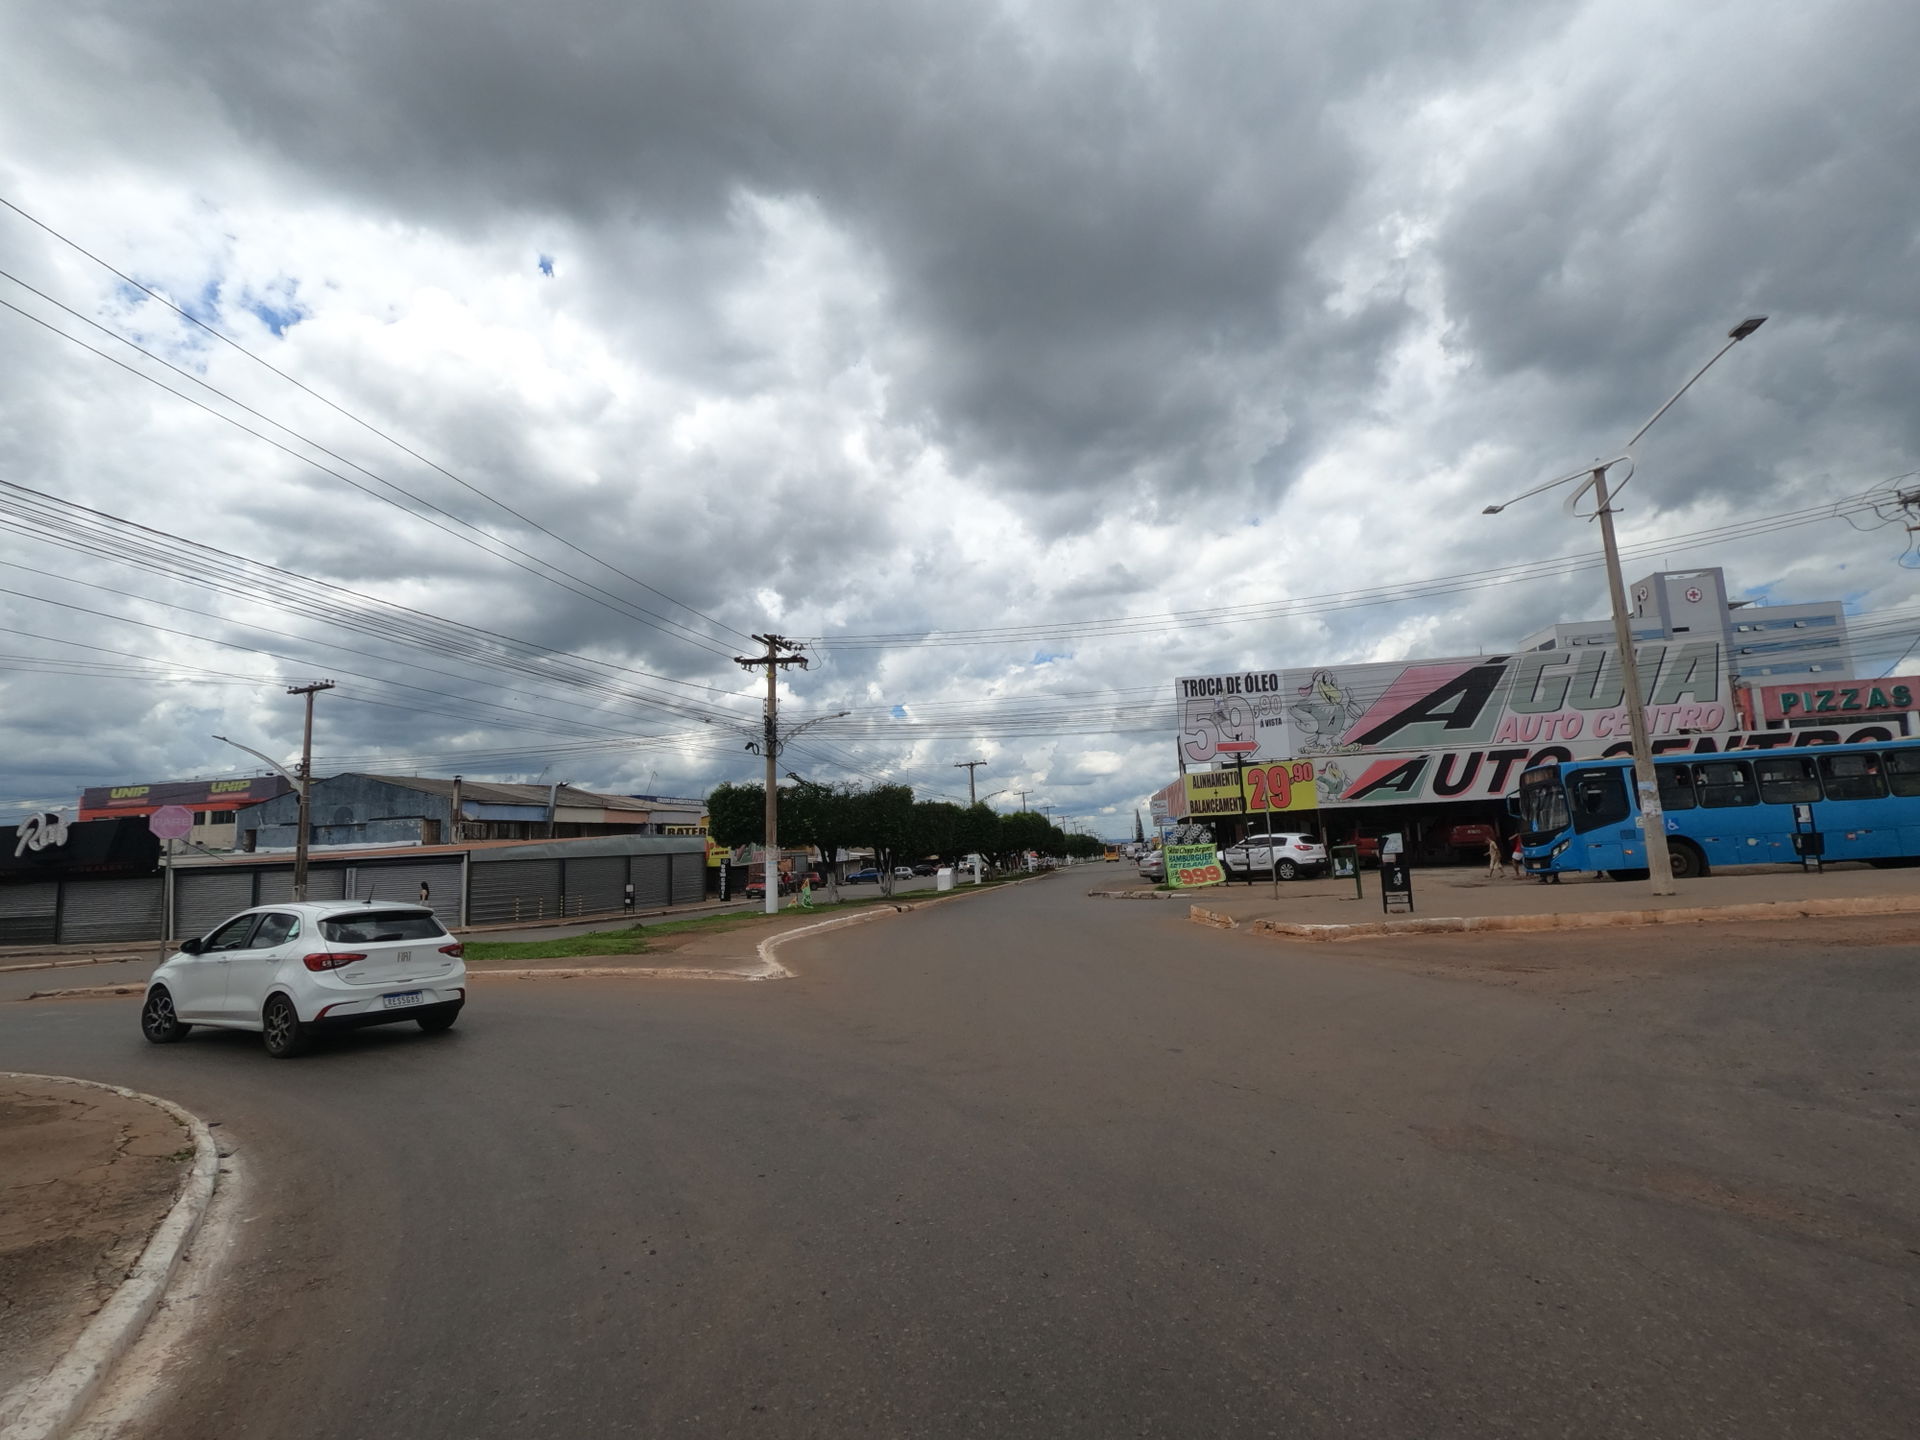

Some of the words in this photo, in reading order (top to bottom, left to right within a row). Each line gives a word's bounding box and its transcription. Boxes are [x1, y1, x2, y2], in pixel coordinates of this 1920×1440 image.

[1182, 678, 1223, 697] TROCA
[1226, 676, 1242, 694] DE
[1244, 672, 1279, 693] ÓLEO
[1780, 685, 1912, 714] PIZZAS
[1496, 711, 1584, 744] AUTO
[1192, 771, 1240, 789] ALINHAMENTO
[110, 786, 150, 799] UNIP
[1190, 796, 1246, 813] BALANCEAMENT
[1169, 852, 1213, 862] HAMBURGUER
[397, 951, 412, 963] FIAT
